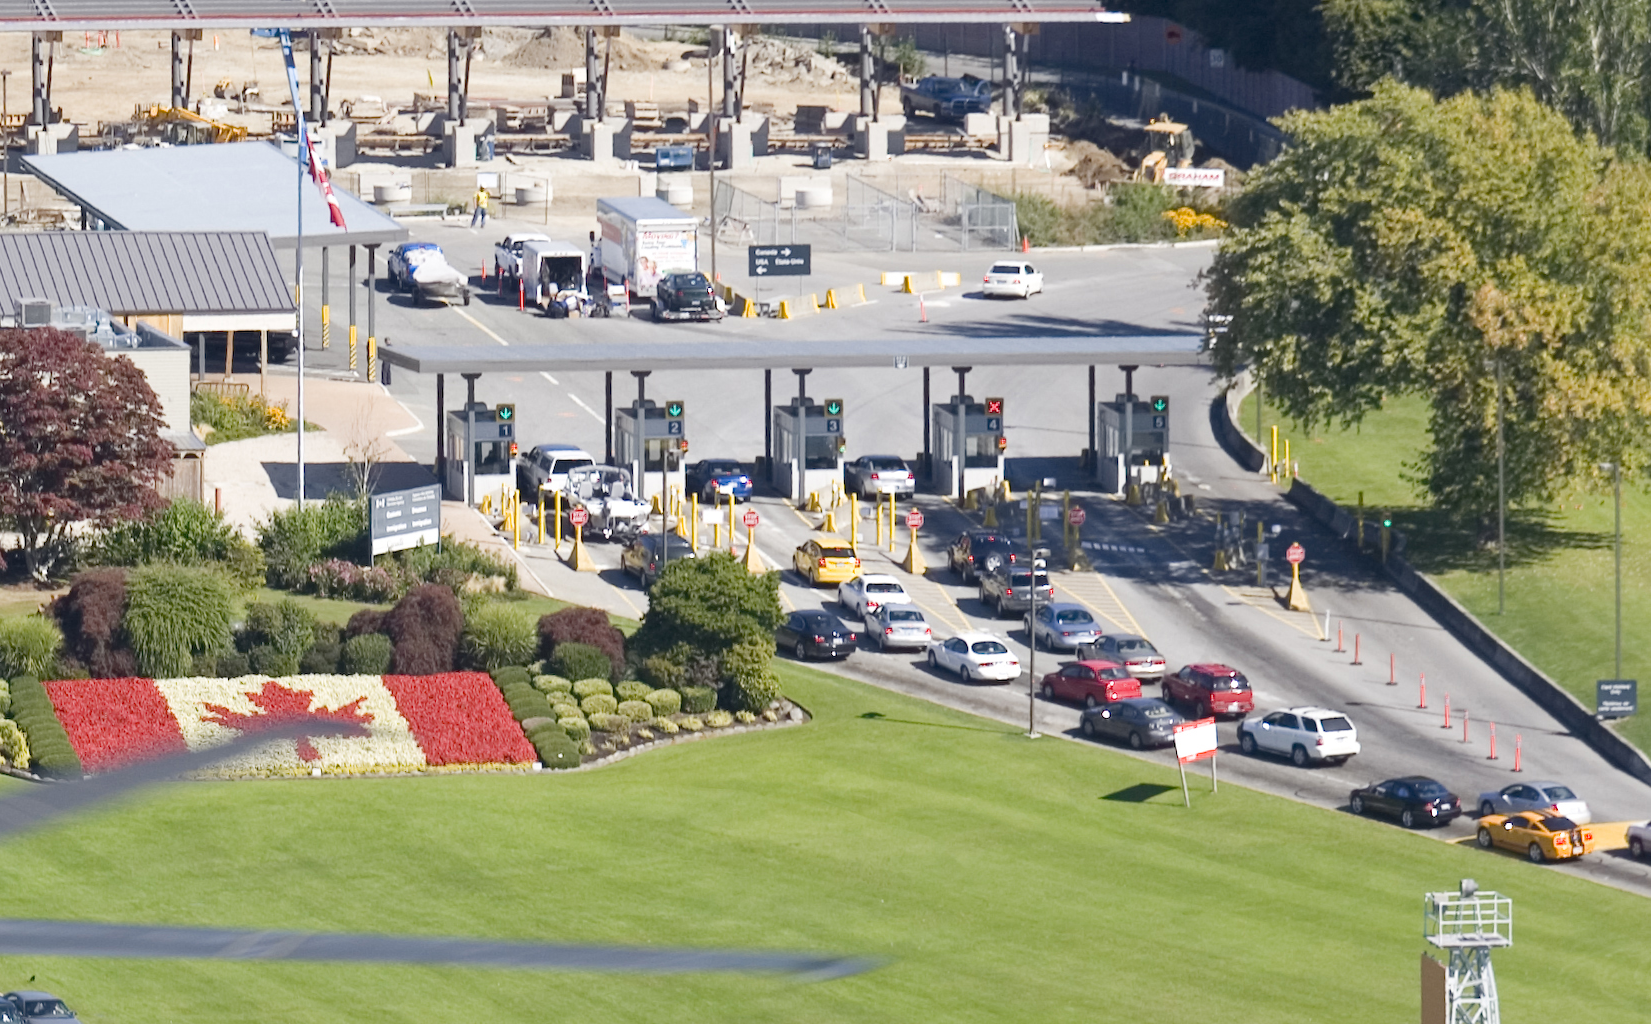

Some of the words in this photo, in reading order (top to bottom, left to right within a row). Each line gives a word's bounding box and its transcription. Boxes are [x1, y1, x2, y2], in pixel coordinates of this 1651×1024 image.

[1168, 172, 1220, 182] GRAHAM
[754, 248, 779, 256] Canada
[755, 258, 769, 266] USA
[671, 422, 679, 433] 2
[829, 420, 838, 431] 3
[989, 419, 997, 430] 4
[1155, 416, 1164, 428] 5
[502, 425, 509, 436] 1
